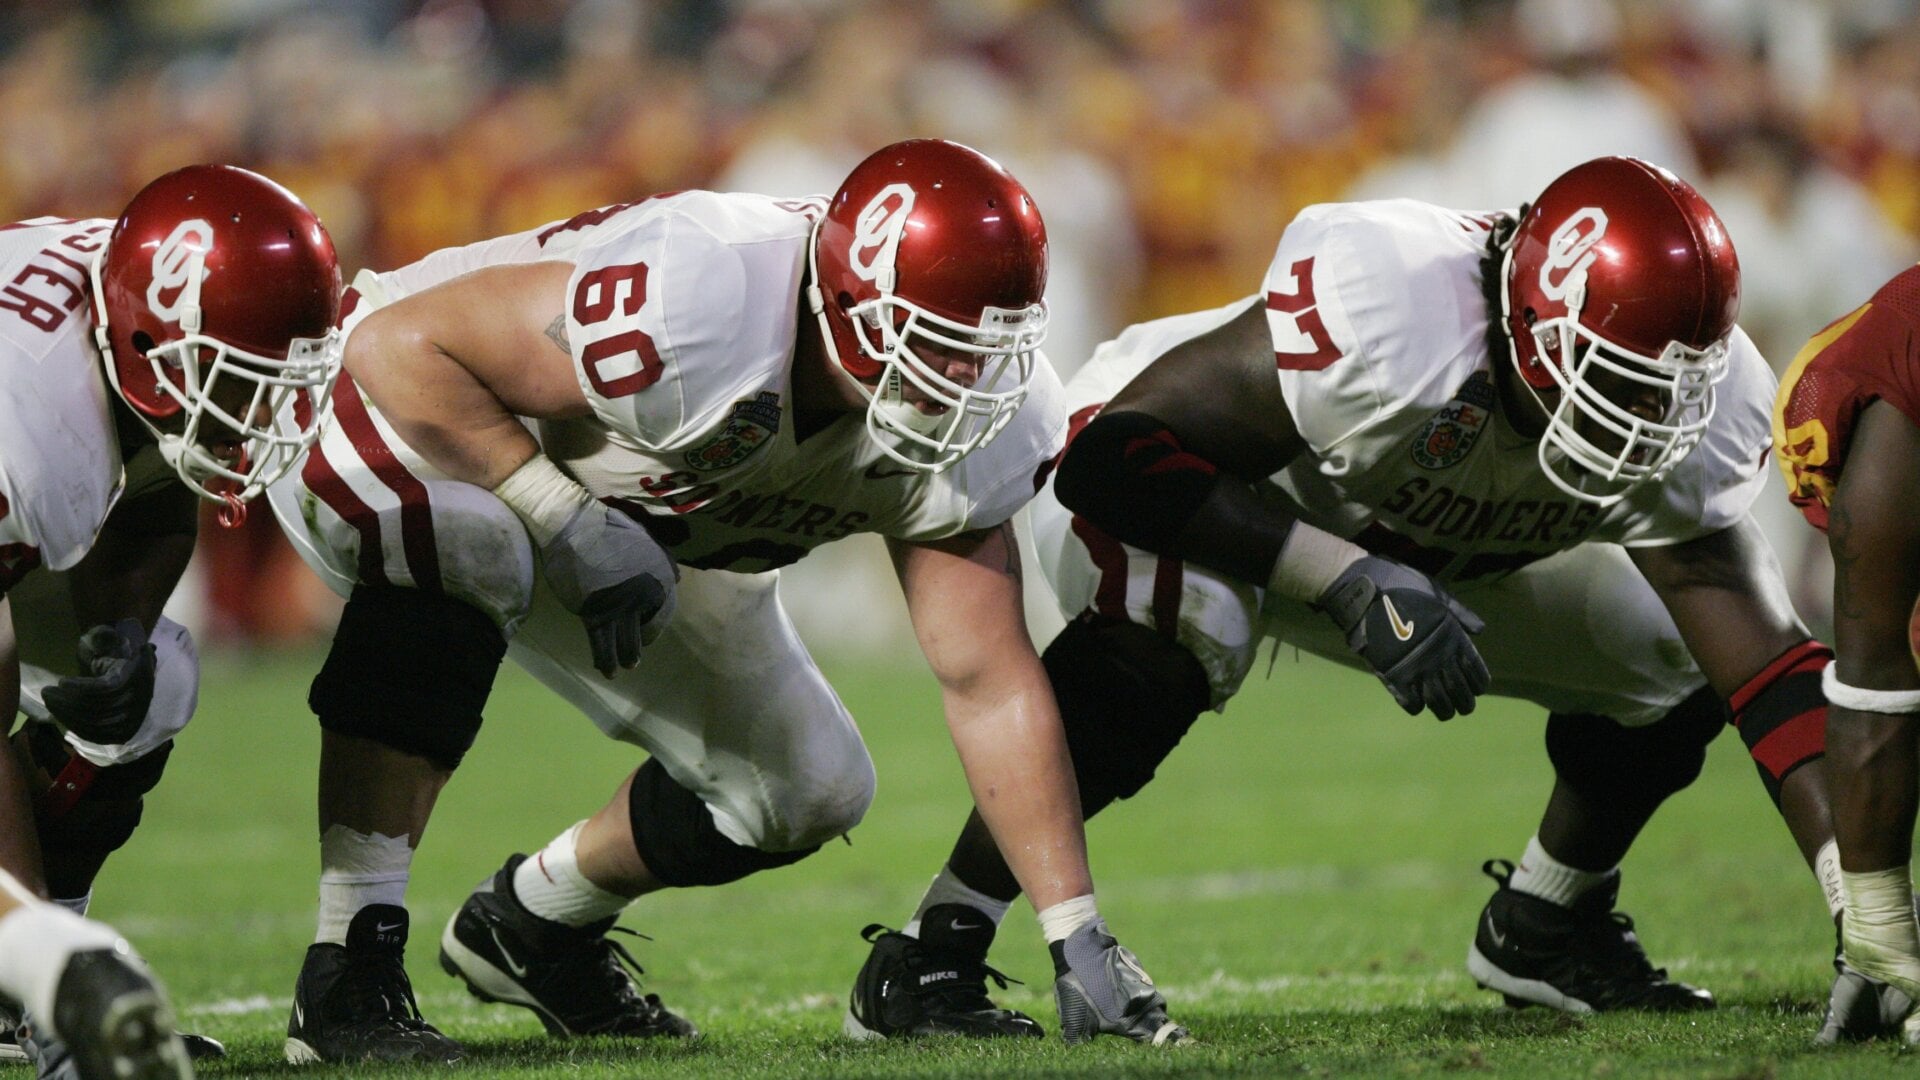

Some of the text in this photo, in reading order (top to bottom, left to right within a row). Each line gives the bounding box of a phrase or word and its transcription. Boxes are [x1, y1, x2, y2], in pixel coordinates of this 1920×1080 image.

[572, 261, 666, 400] 60
[1265, 255, 1345, 372] 77
[1380, 476, 1602, 543] SOONERS
[919, 970, 959, 986] NIKE
